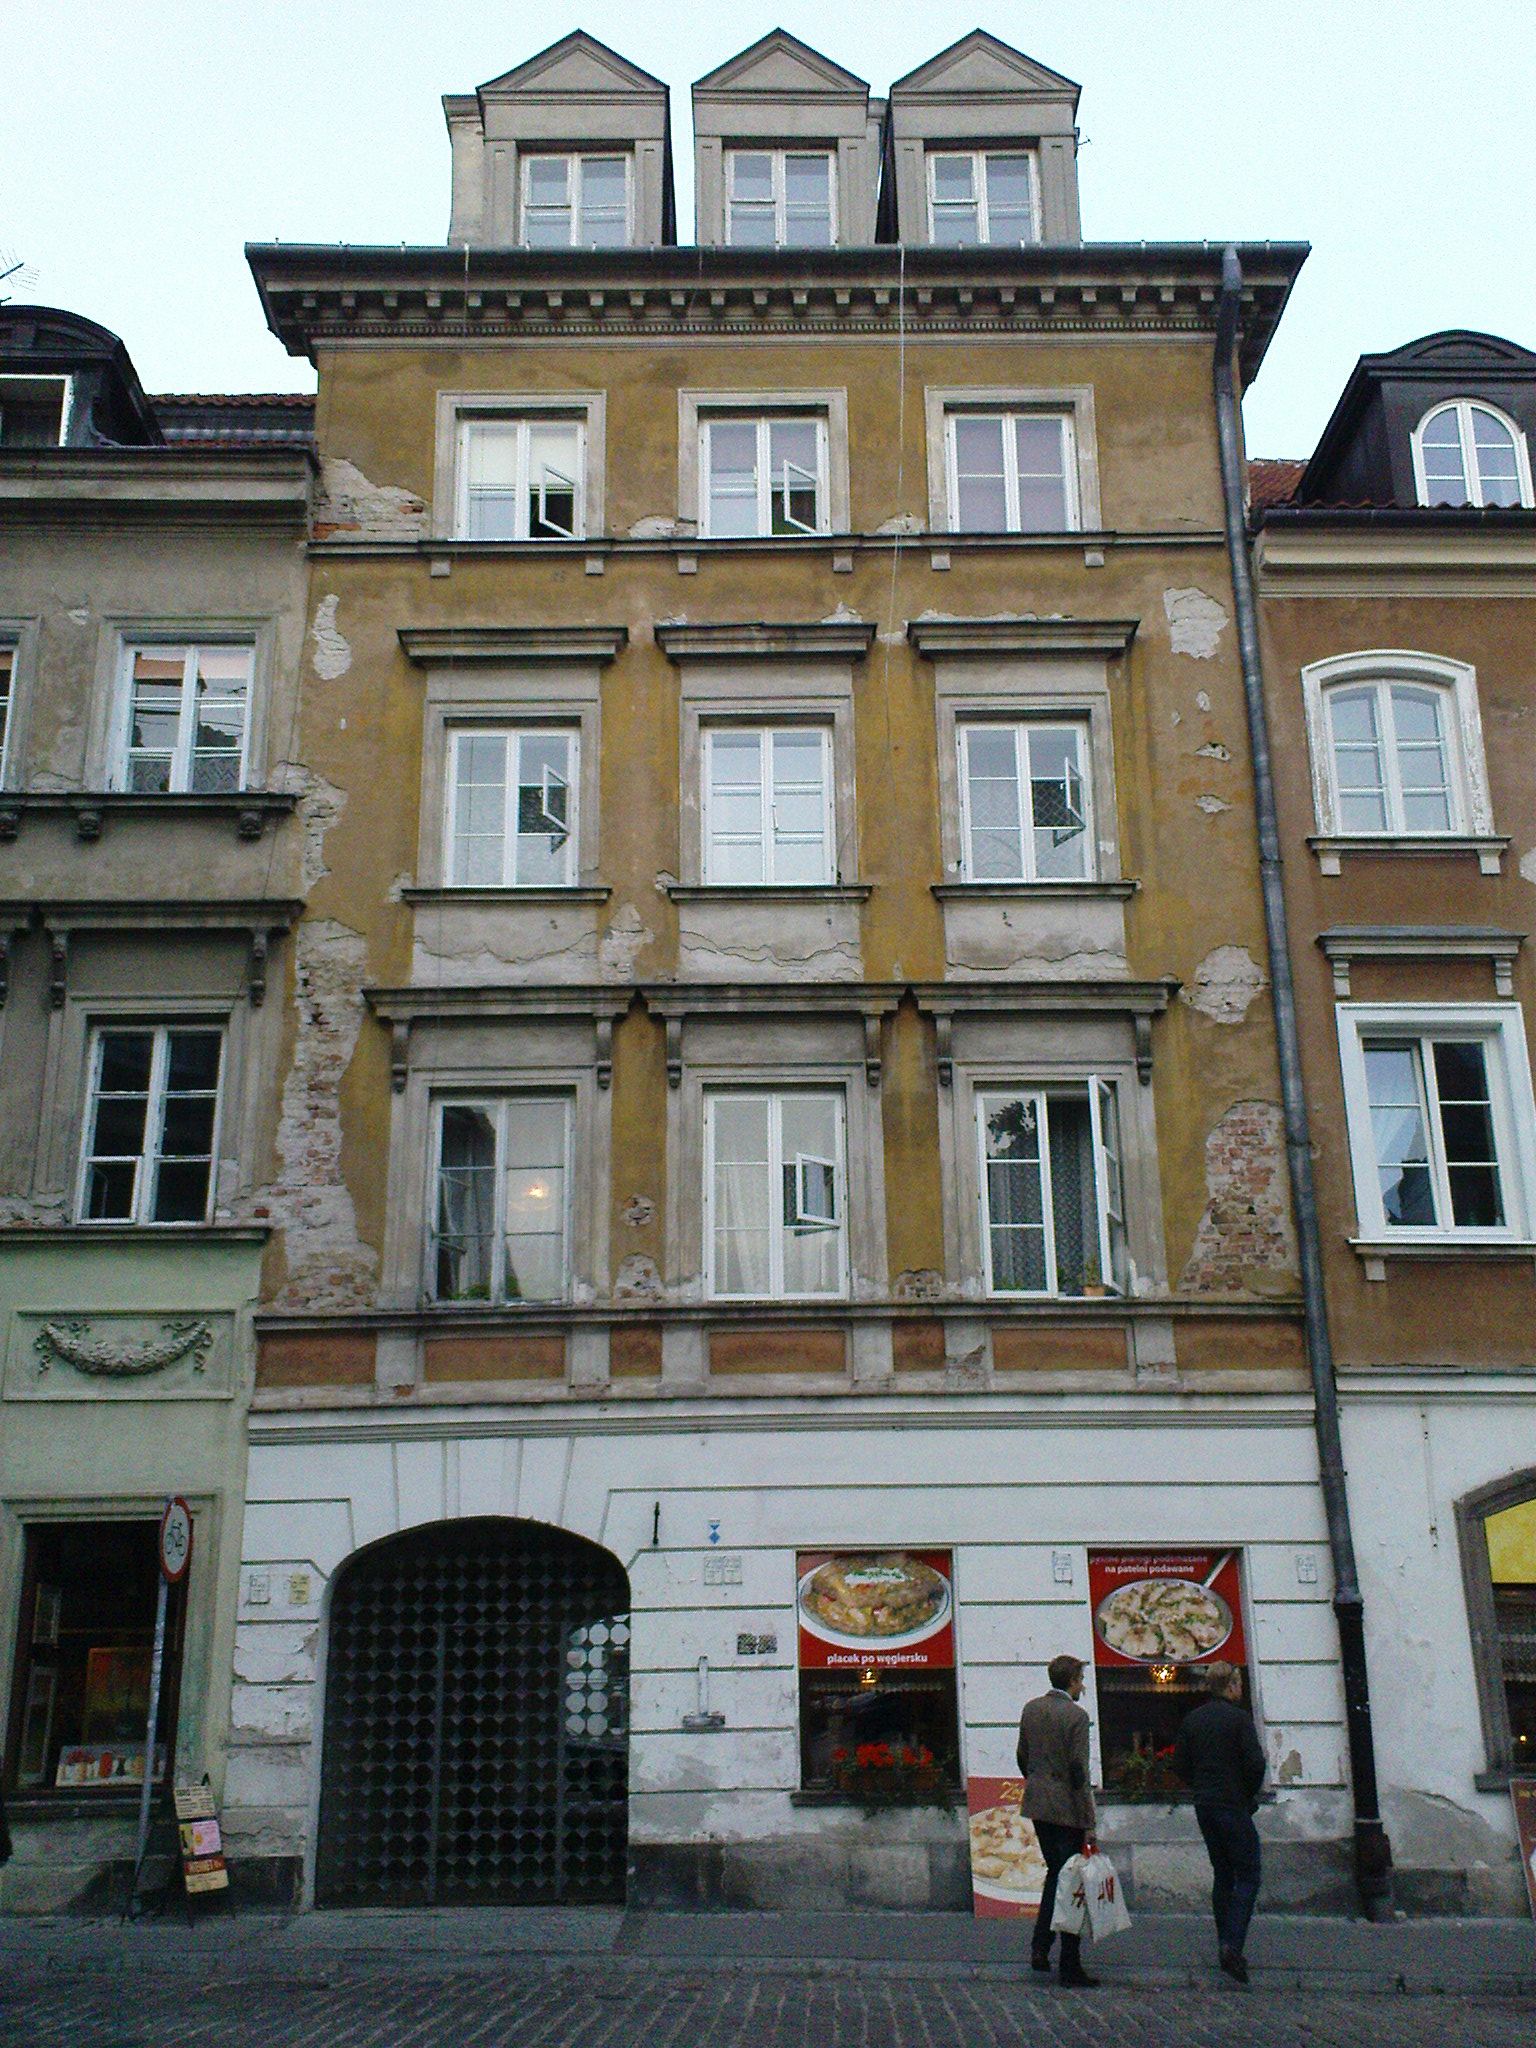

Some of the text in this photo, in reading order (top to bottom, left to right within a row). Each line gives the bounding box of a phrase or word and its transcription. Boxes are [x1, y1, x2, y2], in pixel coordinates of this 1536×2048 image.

[1104, 1564, 1195, 1575] na patelni podawane
[827, 1652, 928, 1665] placek po węgiersku
